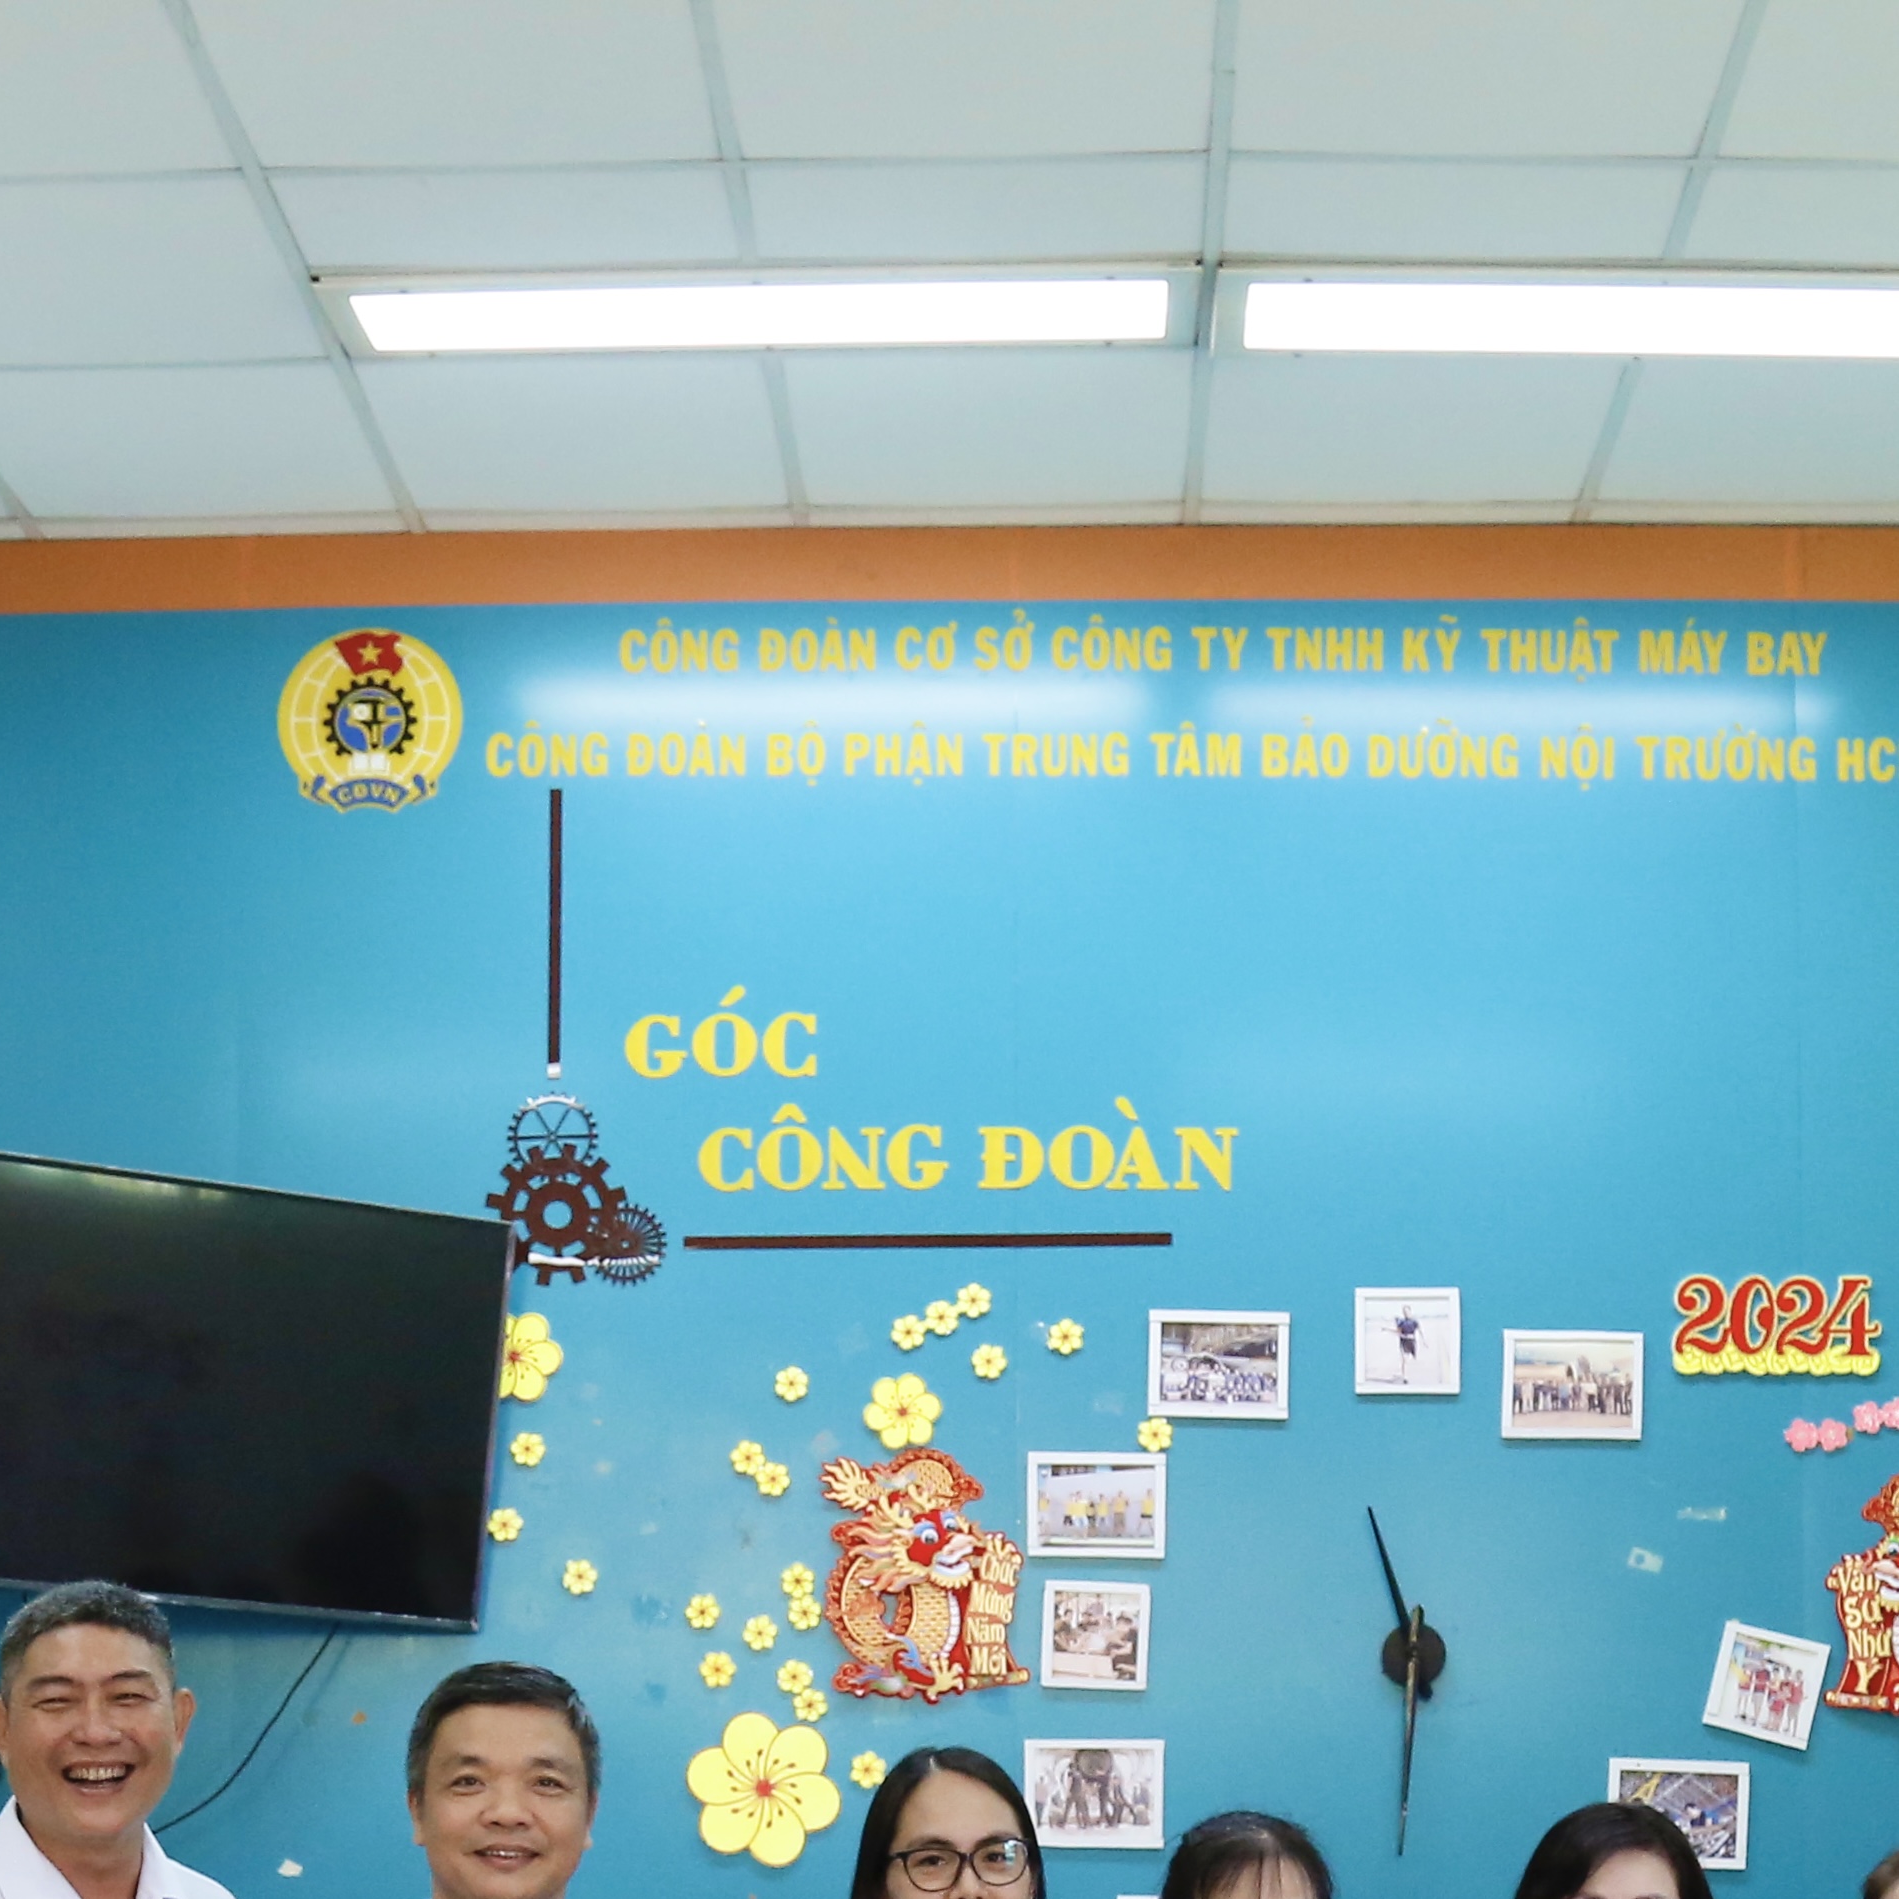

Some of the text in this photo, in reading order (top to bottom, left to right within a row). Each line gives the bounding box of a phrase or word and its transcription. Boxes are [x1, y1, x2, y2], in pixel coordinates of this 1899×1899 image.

[619, 609, 1828, 682] CÔNG ĐOÀN CƠ SỞ CÔNG TY TNHH KỸ THUẬT MÁY BAY
[485, 720, 609, 777] CÔNG
[626, 718, 746, 777] ĐOÀN
[766, 721, 825, 786] BỘ
[844, 720, 962, 786] PHẬN
[982, 731, 1130, 777] TRUNG
[1150, 721, 1242, 777] TÂM
[1261, 715, 1349, 777] BẢO
[1368, 717, 1519, 778] DƯỠNG
[1540, 723, 1615, 791] NỘI
[1635, 723, 1816, 782] TRƯỜNG
[625, 984, 818, 1079] GÓC
[698, 1096, 1239, 1193] CÔNG ĐOÀN
[1673, 1275, 1882, 1357] 2024
[966, 1616, 1007, 1645] Năm
